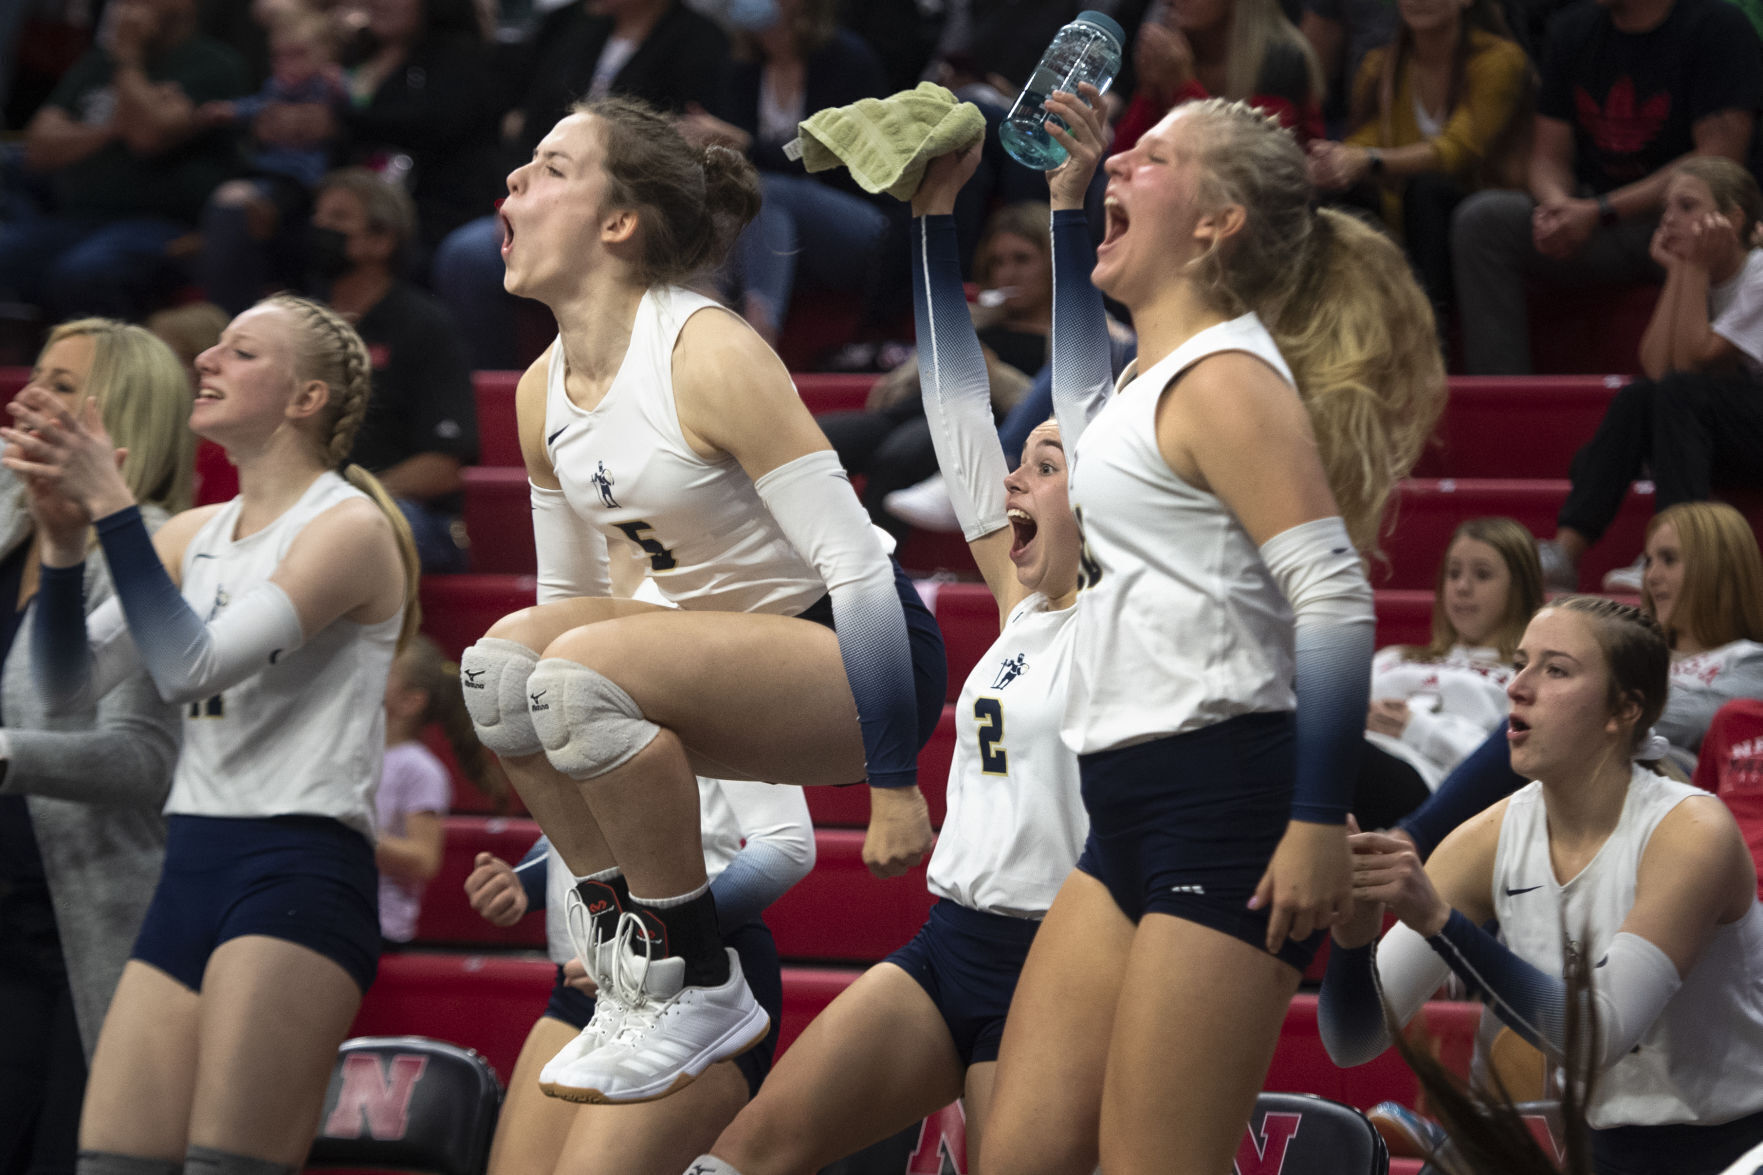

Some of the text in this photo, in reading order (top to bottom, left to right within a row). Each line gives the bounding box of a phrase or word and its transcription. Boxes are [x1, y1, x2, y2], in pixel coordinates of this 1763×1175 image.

[608, 520, 678, 573] 5
[973, 696, 1009, 778] 2
[325, 1053, 429, 1141] N
